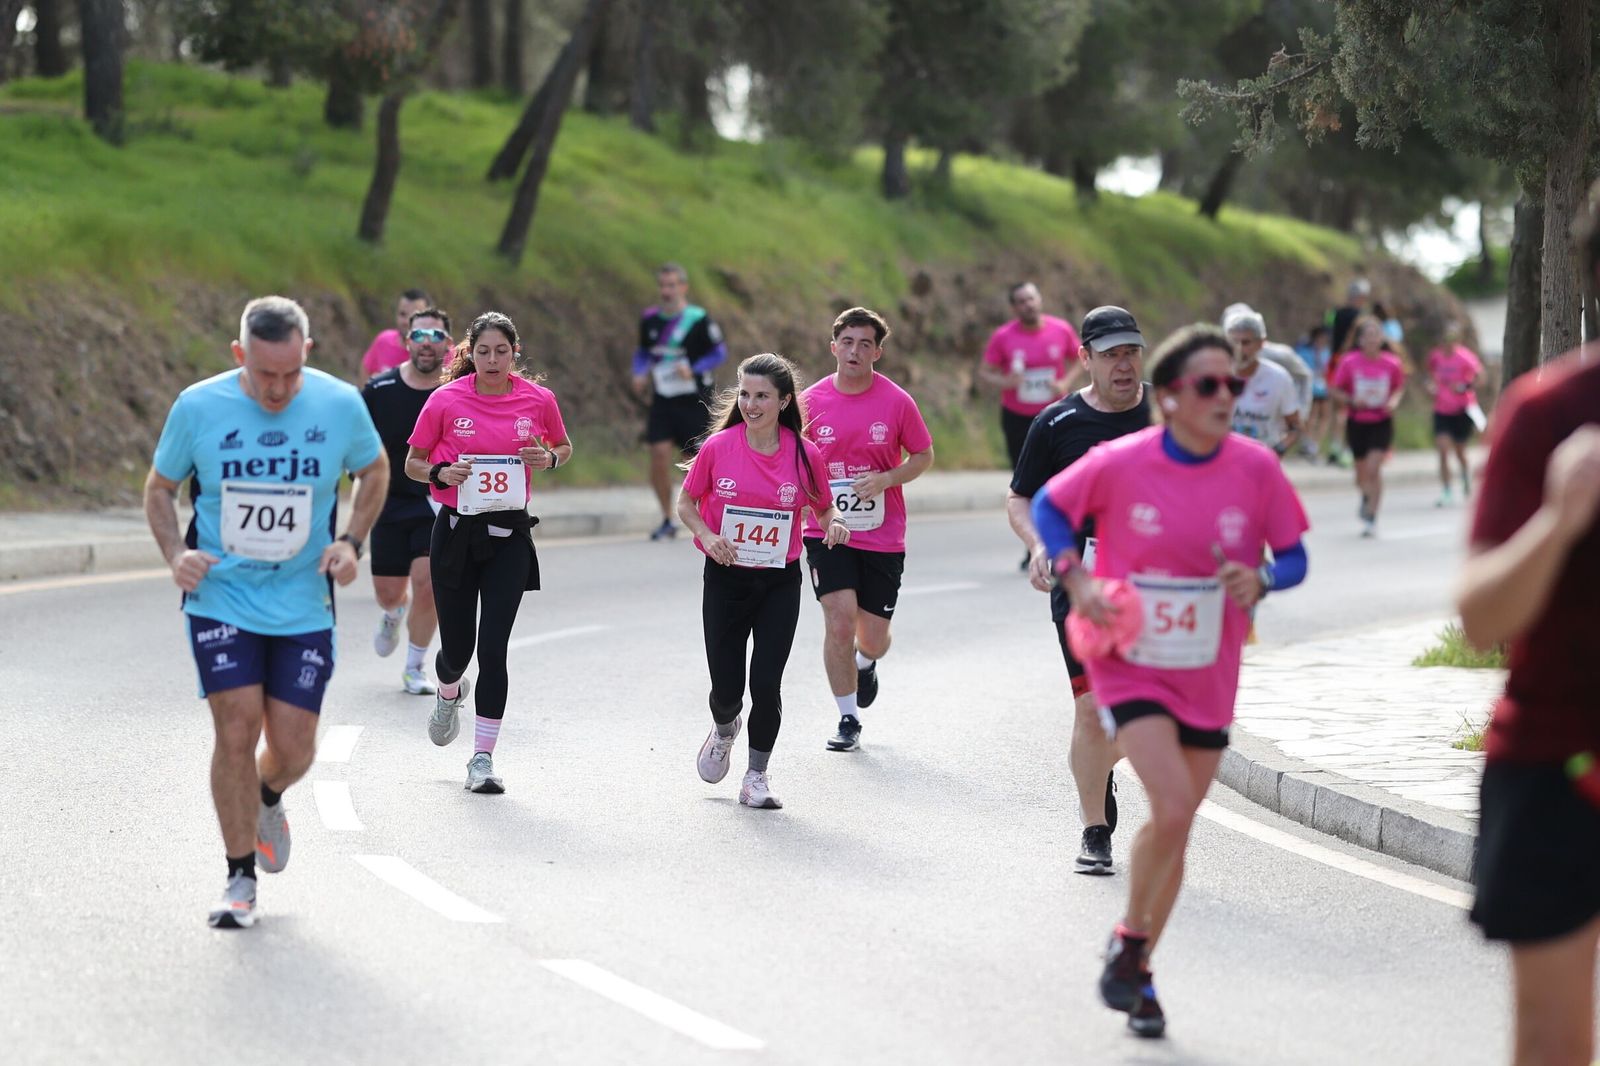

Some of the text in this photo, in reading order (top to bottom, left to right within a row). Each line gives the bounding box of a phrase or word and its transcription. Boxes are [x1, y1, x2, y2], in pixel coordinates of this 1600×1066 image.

[221, 449, 320, 482] nerja
[478, 472, 508, 493] 38
[237, 504, 296, 532] 704
[733, 523, 779, 546] 144
[1154, 602, 1198, 635] 54
